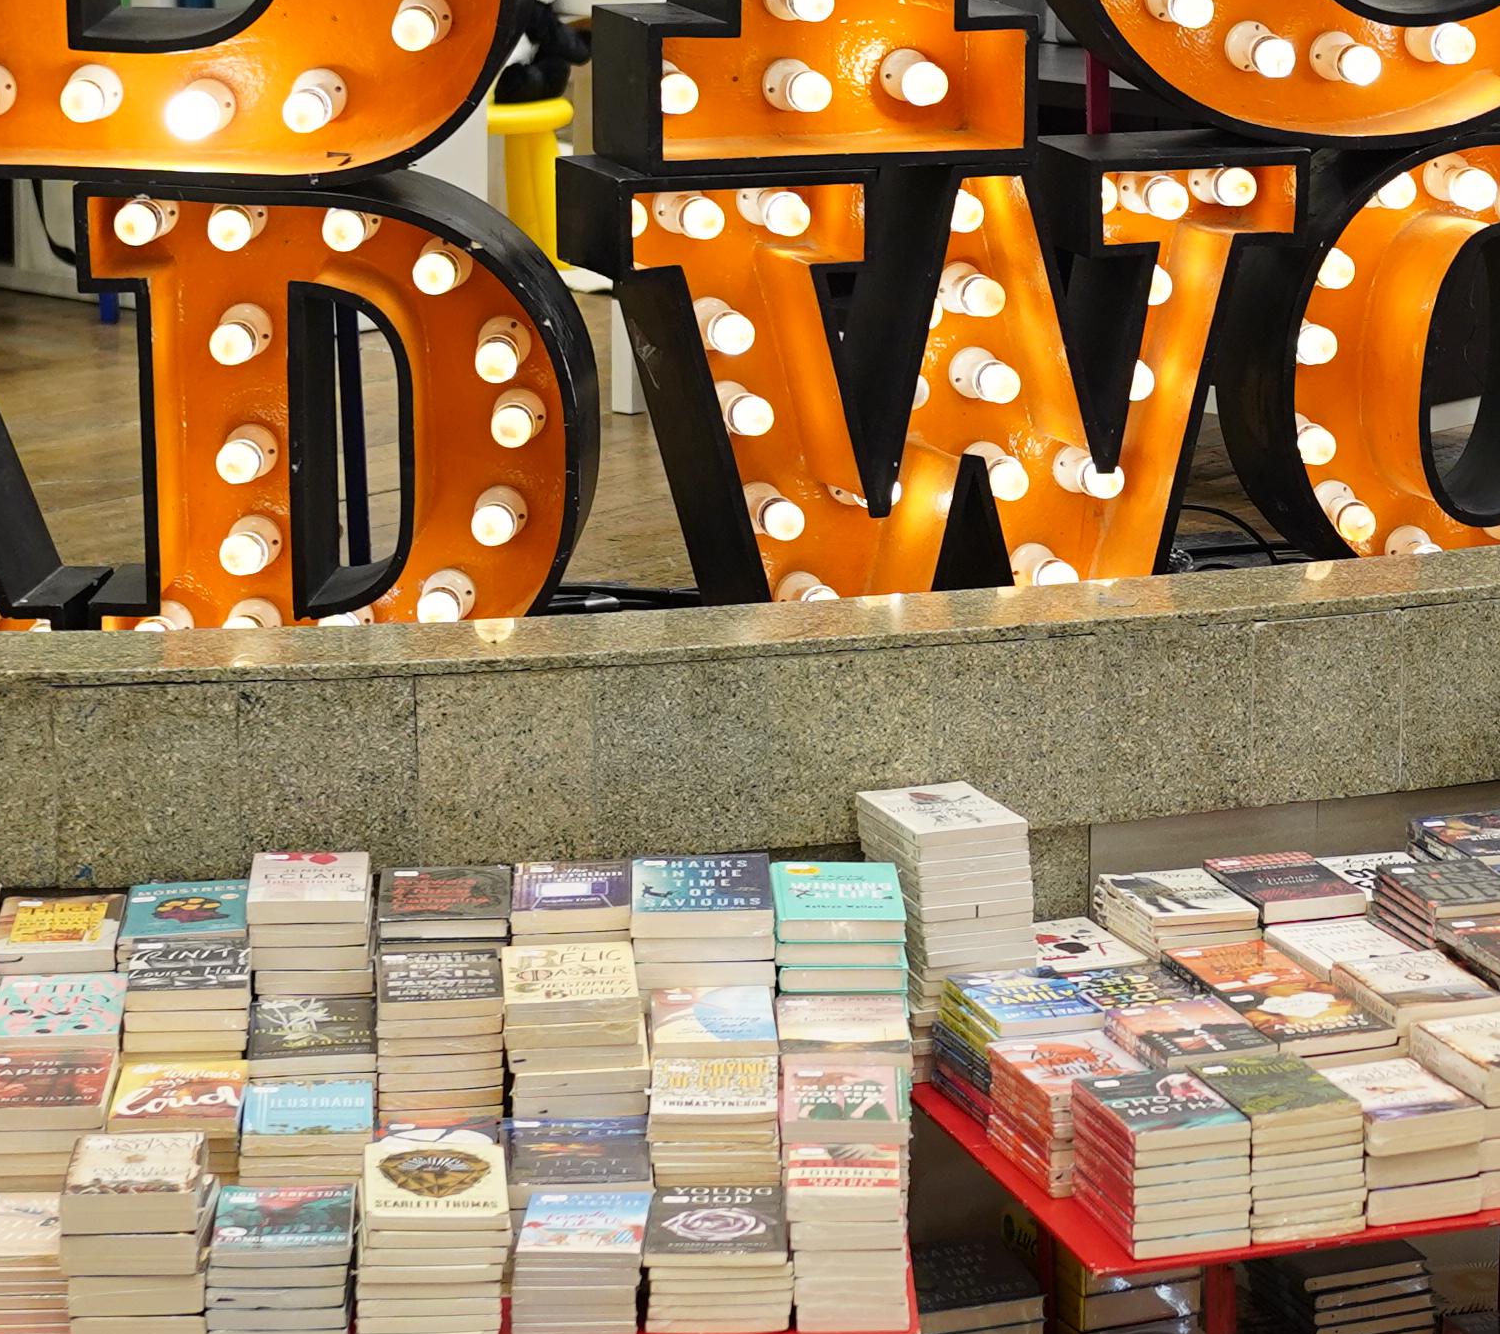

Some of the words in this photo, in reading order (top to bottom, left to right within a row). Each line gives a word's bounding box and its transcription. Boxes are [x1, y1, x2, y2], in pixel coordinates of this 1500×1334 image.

[674, 879, 731, 888] TIME
[790, 882, 894, 893] WINNING
[136, 885, 247, 897] MONSTRESS
[644, 897, 761, 907] SAVIOURS
[131, 947, 251, 962] TRINITY
[269, 1097, 365, 1107] ILUSTRADO
[1110, 1093, 1206, 1108] GHOST
[1126, 1101, 1207, 1117] MOTH
[673, 1187, 773, 1196] YOUNG
[374, 1199, 450, 1209] SCARLETT
[453, 1199, 498, 1208] THOMAS
[690, 1194, 754, 1204] GOD
